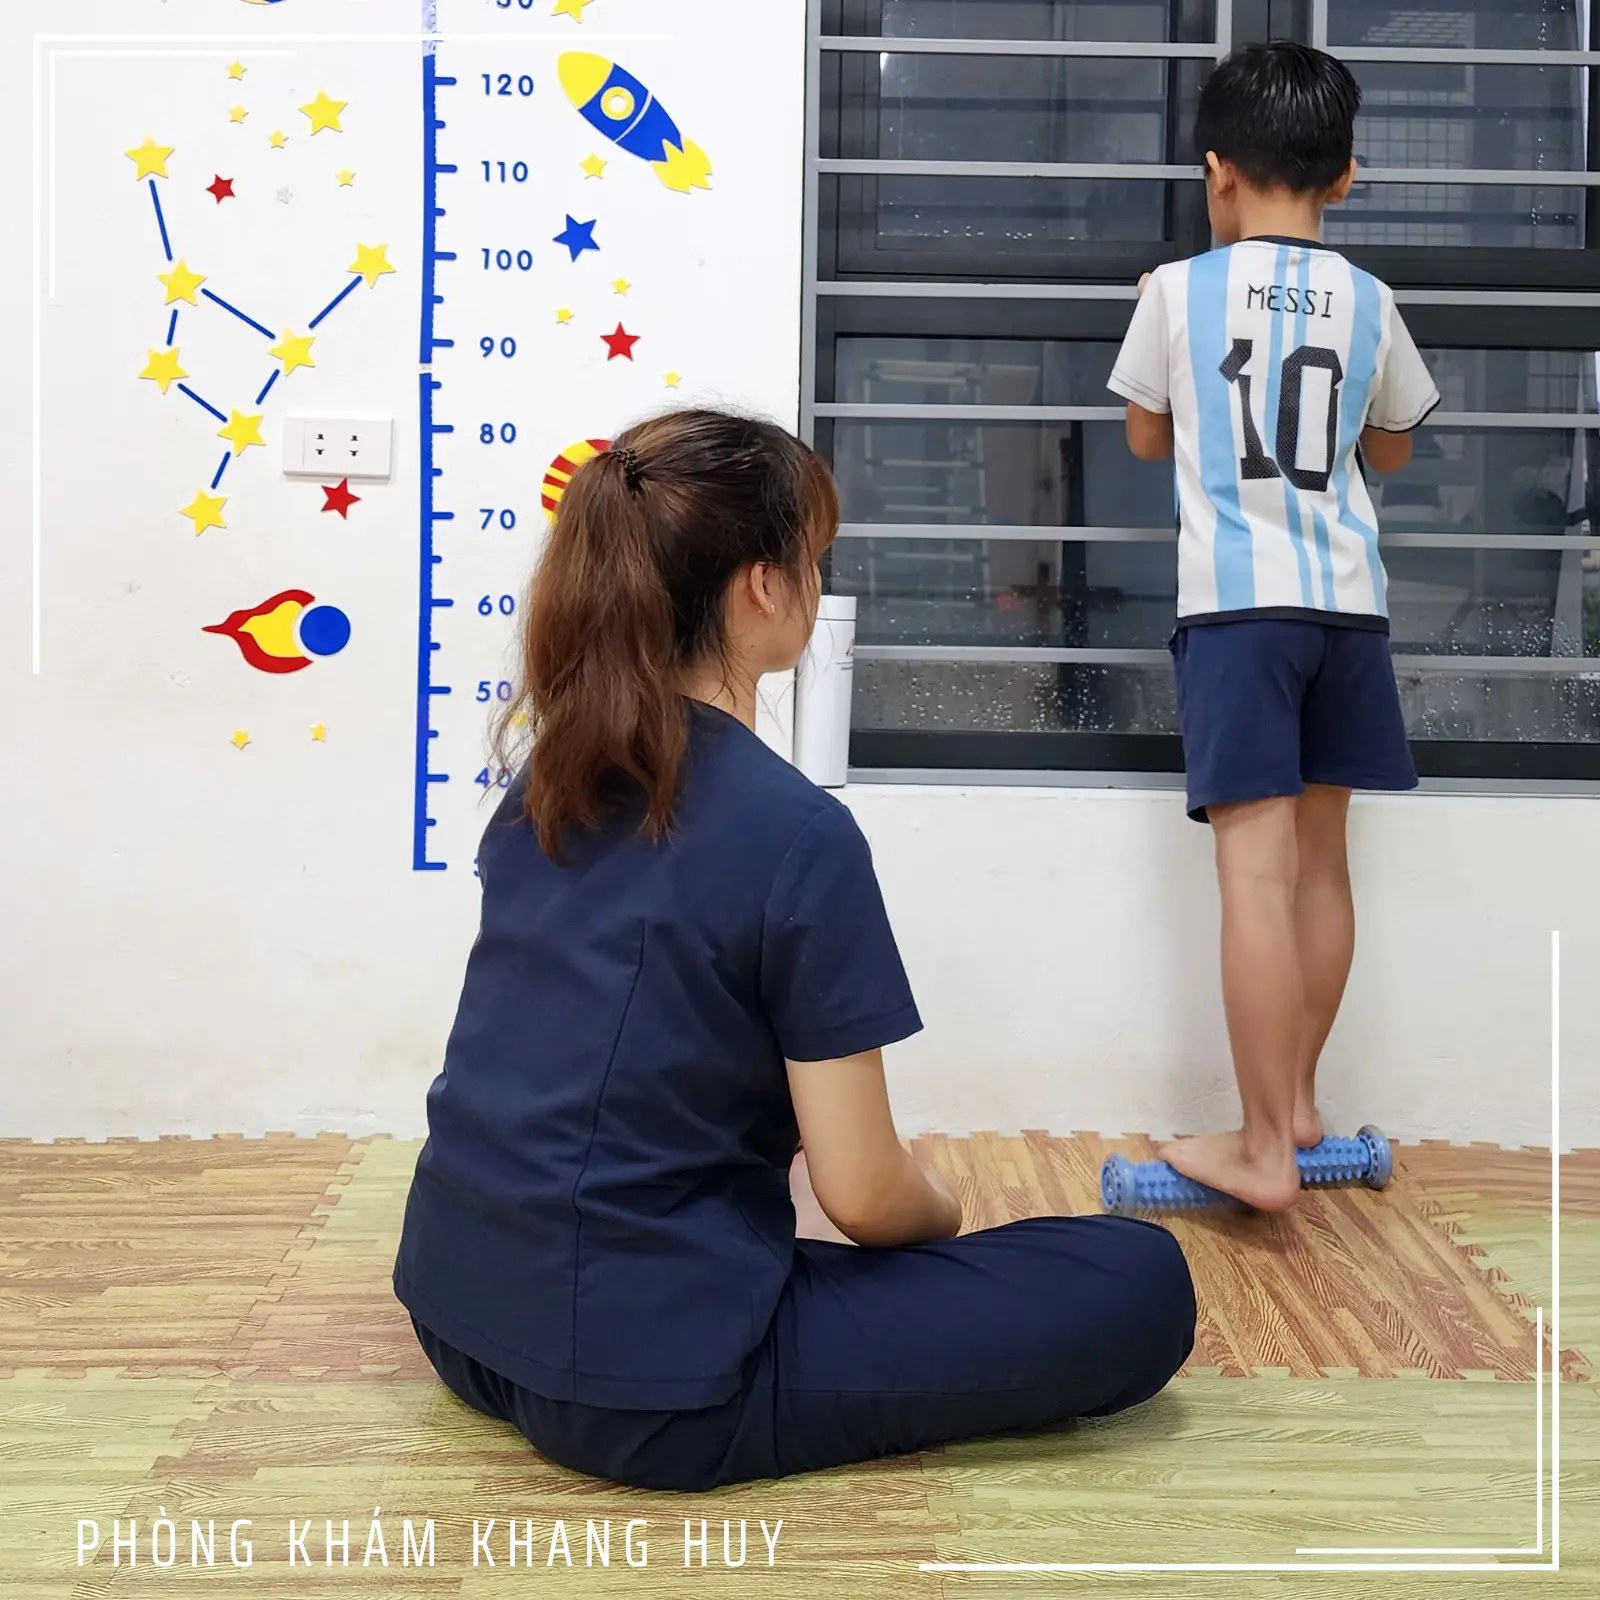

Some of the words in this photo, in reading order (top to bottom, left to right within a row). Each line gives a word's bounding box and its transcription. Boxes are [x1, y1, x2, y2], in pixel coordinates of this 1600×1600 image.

[481, 73, 535, 97] 120
[481, 160, 529, 183] 110
[481, 247, 534, 272] 100
[1247, 283, 1334, 319] MESSI
[479, 336, 517, 359] 90
[1218, 337, 1344, 493] 10
[479, 422, 517, 445] 80
[479, 508, 517, 531] 70
[477, 594, 516, 617] 60
[475, 680, 513, 703] 50
